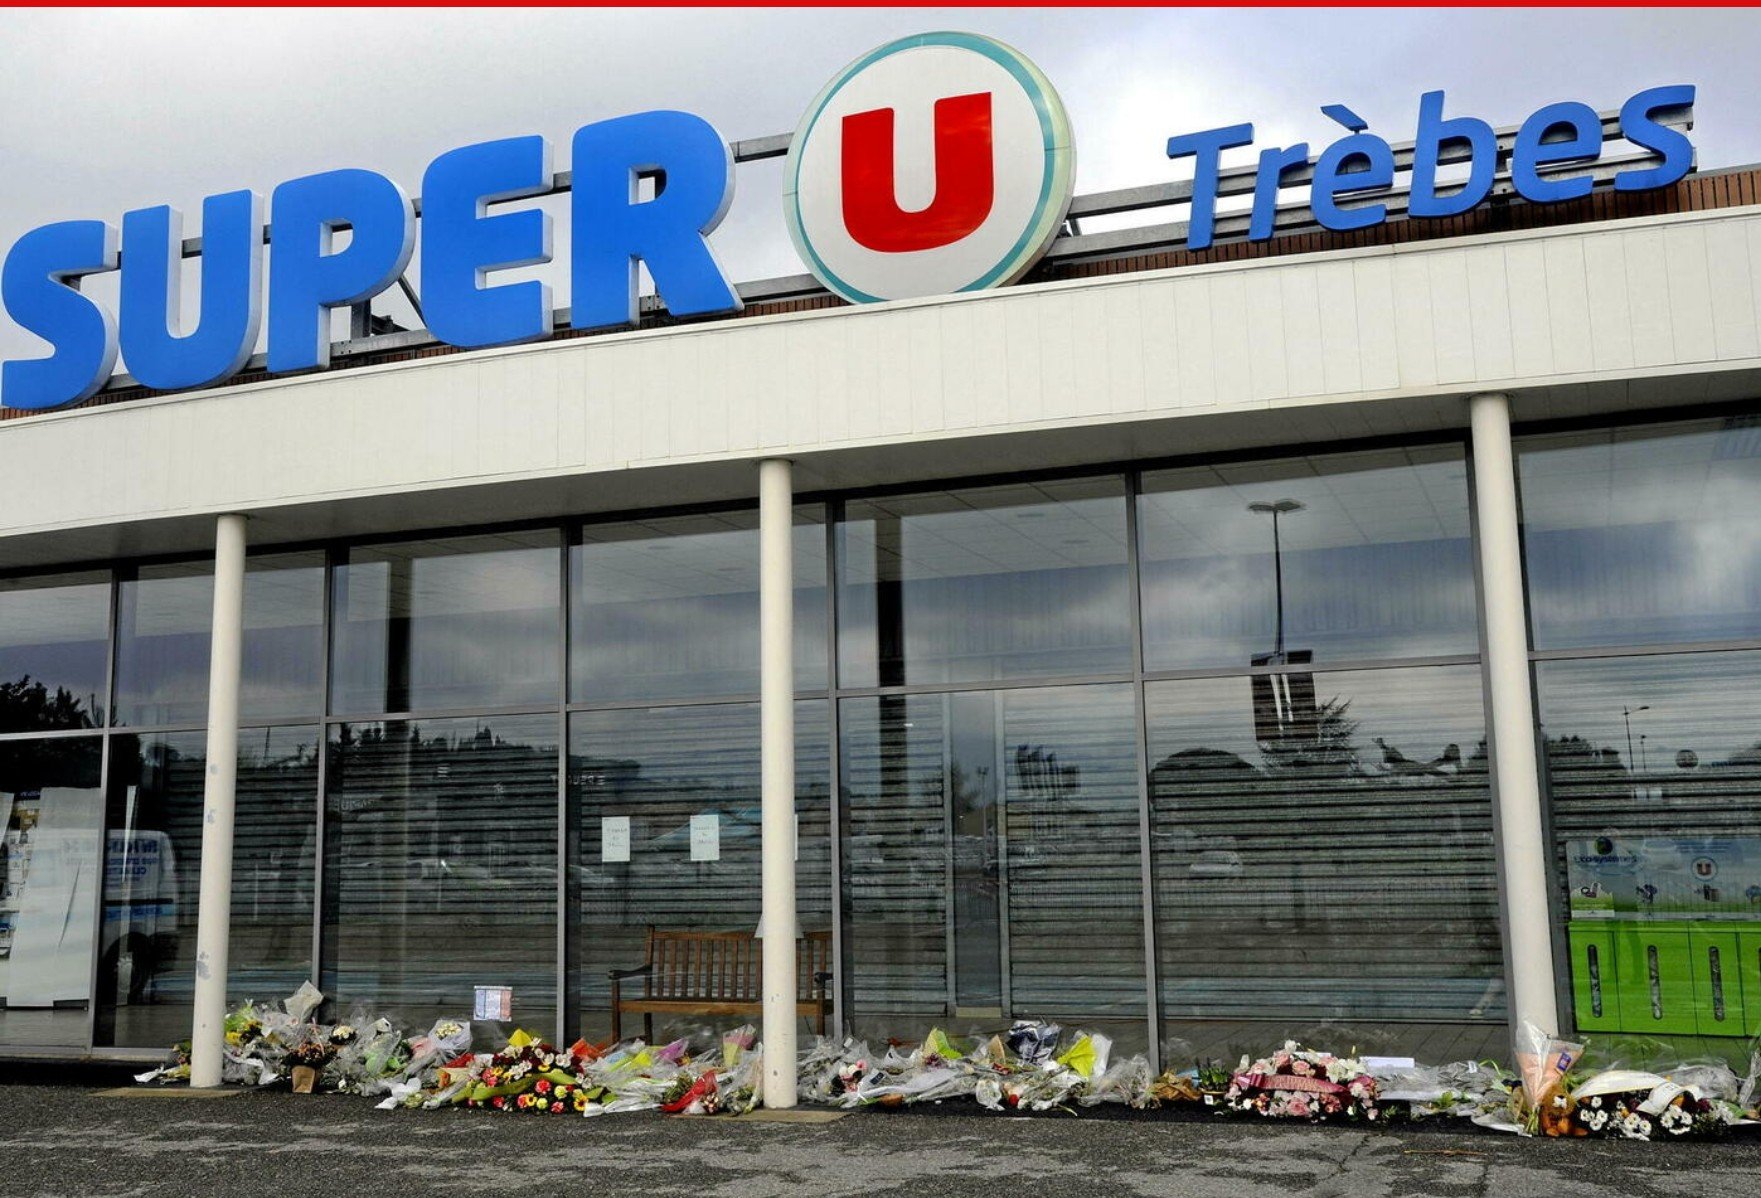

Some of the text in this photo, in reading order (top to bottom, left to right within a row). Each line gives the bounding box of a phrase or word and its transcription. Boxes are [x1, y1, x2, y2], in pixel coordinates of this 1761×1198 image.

[1, 91, 995, 411] SUPER U
[1166, 84, 1697, 252] Trèbes
[1696, 862, 1712, 877] U
